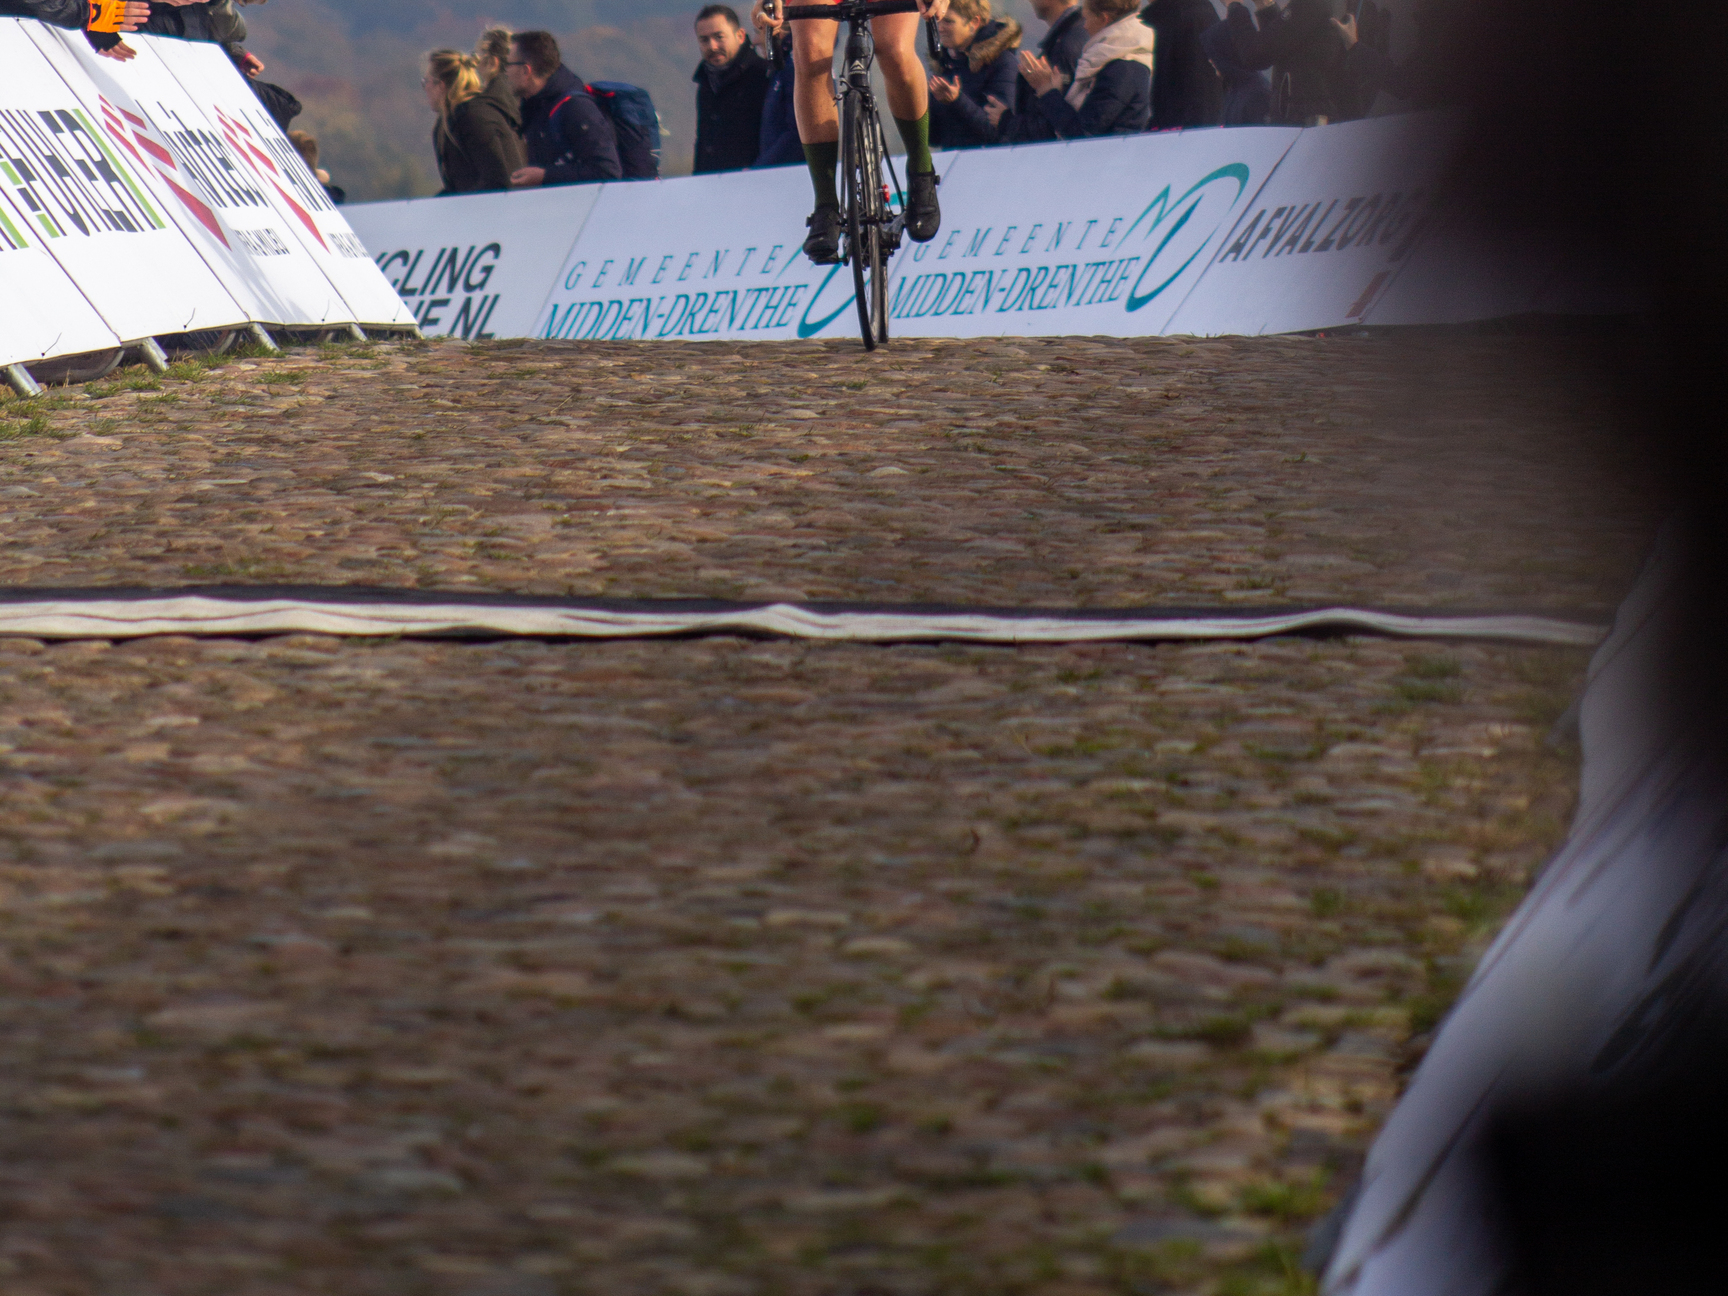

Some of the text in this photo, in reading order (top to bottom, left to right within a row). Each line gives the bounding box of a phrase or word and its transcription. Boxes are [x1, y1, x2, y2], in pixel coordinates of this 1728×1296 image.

[135, 99, 269, 208] Avitec
[375, 242, 501, 297] CLING
[564, 244, 783, 291] GEMEENTE
[888, 256, 1141, 319] MIDDEN-DRENTHE
[538, 284, 809, 341] MIDDEN-DRENTHE
